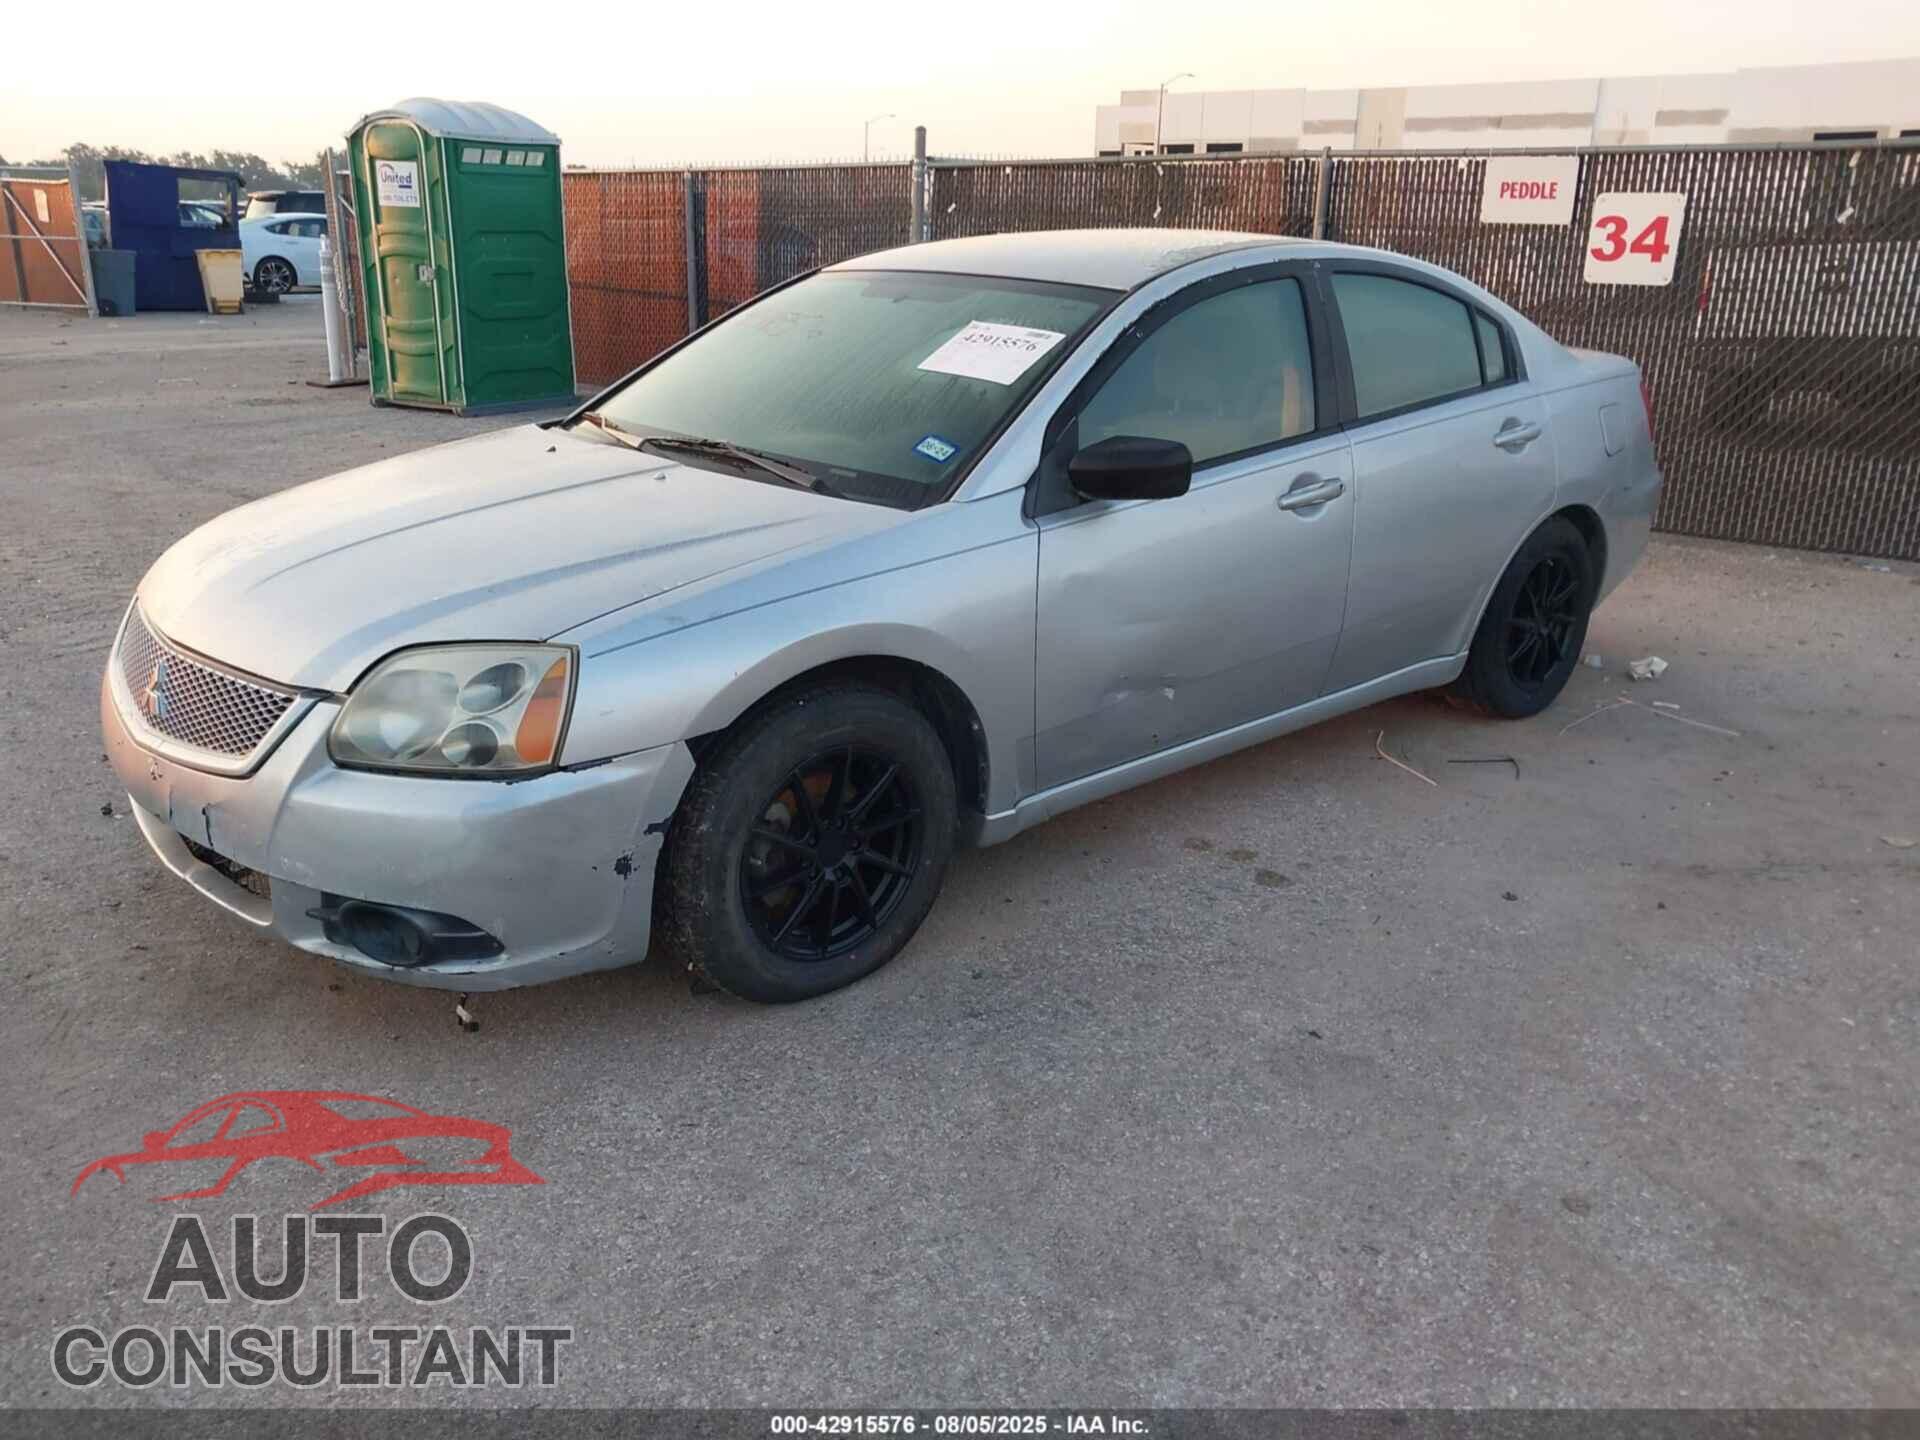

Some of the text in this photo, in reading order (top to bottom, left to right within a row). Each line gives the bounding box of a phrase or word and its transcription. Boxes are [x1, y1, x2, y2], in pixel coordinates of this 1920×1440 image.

[381, 171, 412, 184] United
[1500, 181, 1559, 200] PEDDLE
[1590, 215, 1670, 263] 34
